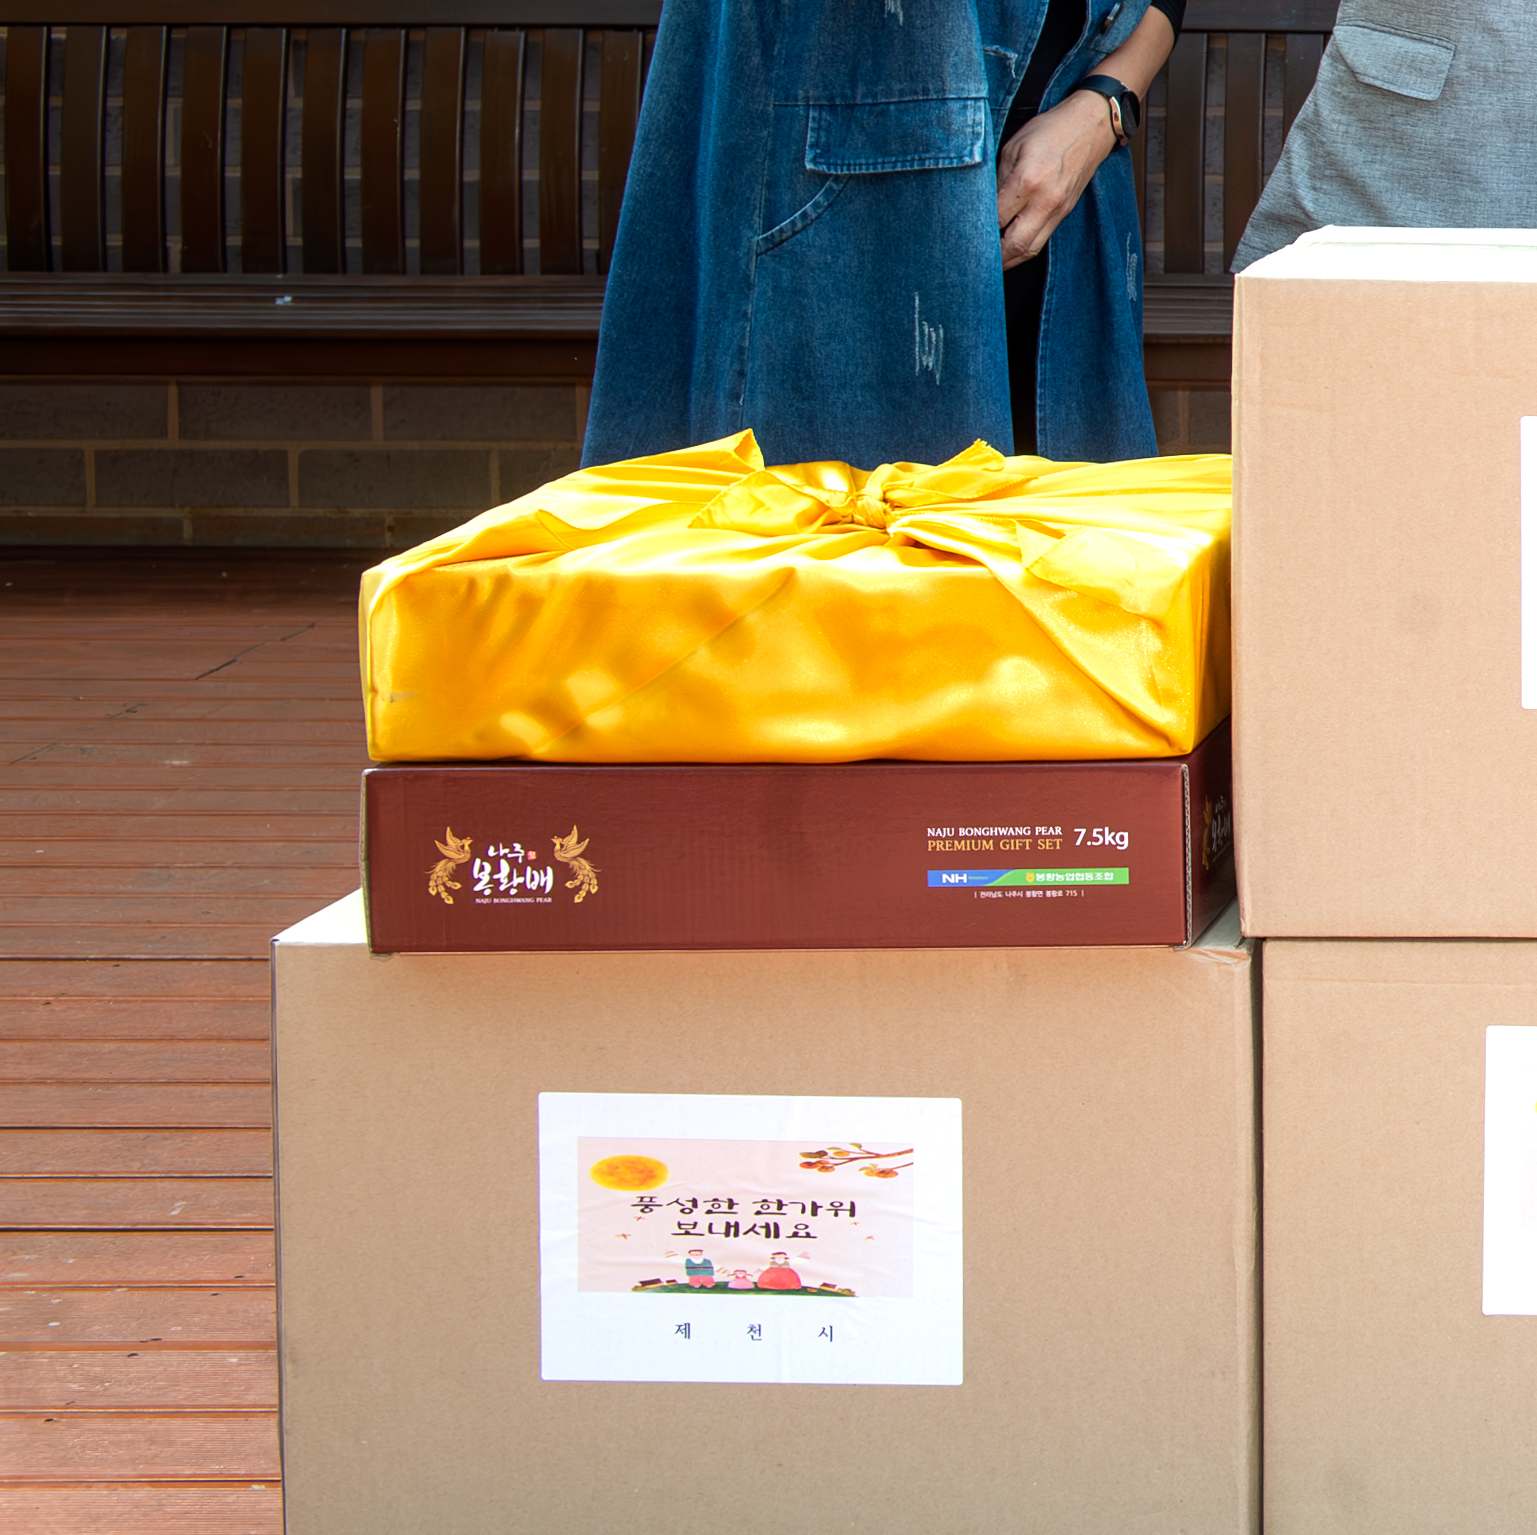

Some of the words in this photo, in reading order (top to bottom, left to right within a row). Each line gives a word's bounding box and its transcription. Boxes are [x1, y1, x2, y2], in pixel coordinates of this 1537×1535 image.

[927, 827, 954, 837] NAJU
[959, 827, 1031, 836] BONGHWANG
[1035, 826, 1062, 836] PEAR
[1074, 827, 1129, 850] 7.5kg
[927, 839, 994, 851] PREMIUM
[1000, 839, 1032, 850] GIFT
[1038, 839, 1062, 850] SET
[488, 843, 525, 863] 나주
[472, 858, 554, 895] 봉황배
[942, 873, 967, 883] NH
[631, 1196, 739, 1215] 풍성한
[752, 1198, 856, 1218] 한가위
[671, 1220, 818, 1240] 보내세요
